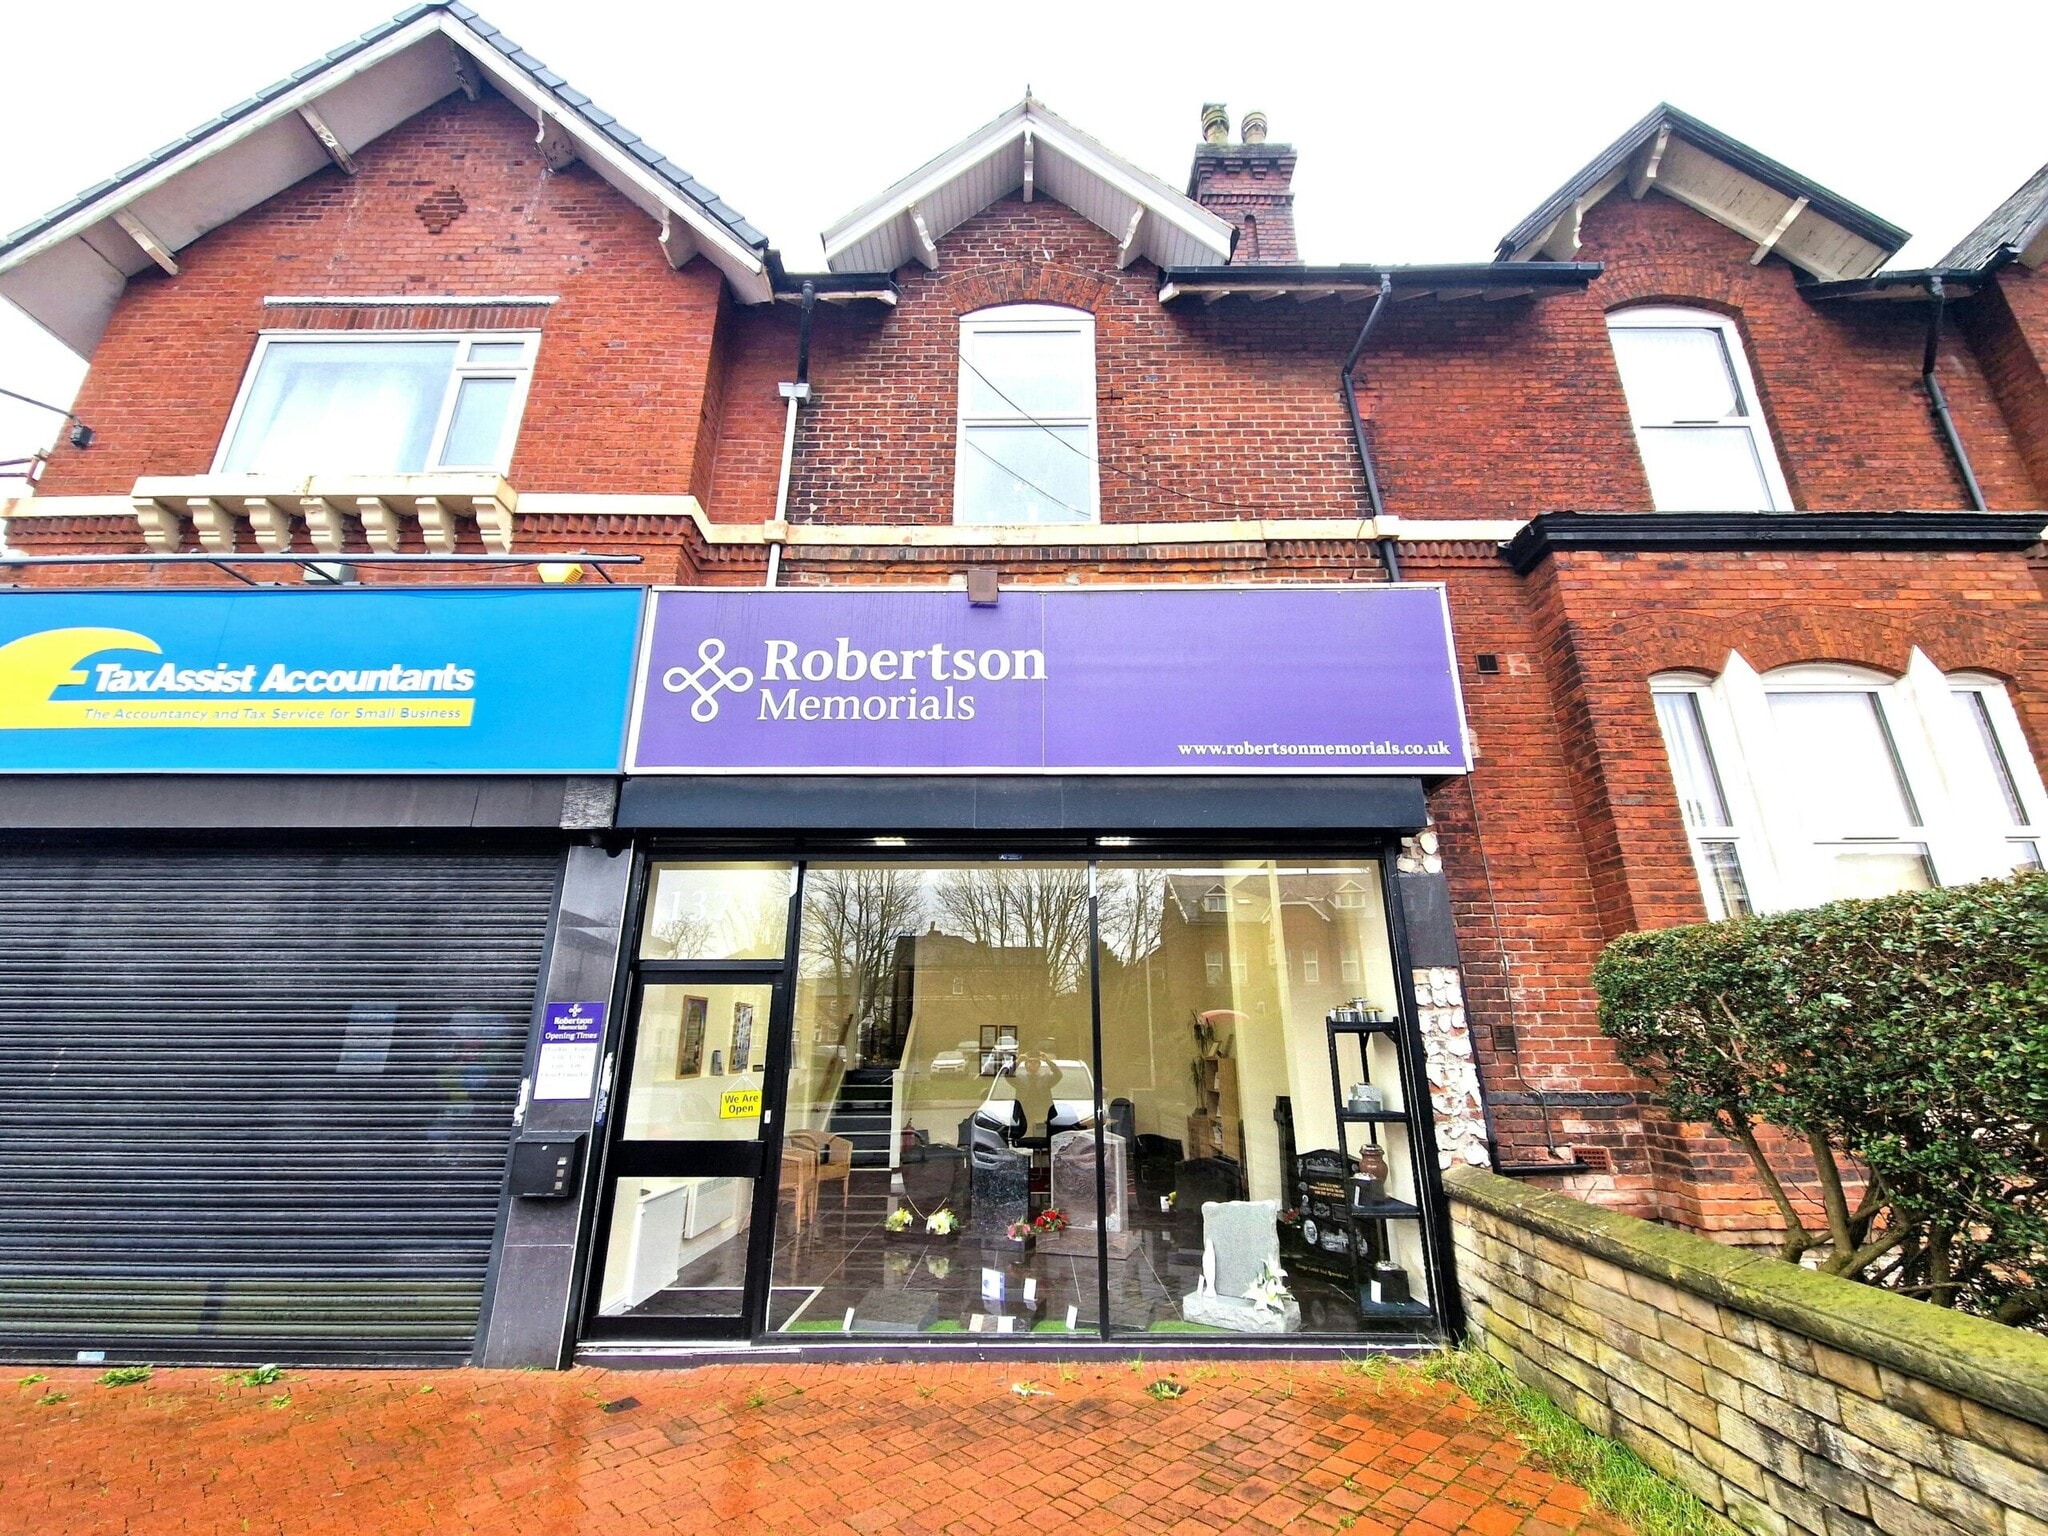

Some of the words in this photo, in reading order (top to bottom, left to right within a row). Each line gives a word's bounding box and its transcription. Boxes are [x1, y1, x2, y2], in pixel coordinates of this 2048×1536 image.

[760, 637, 1048, 682] Robertson
[95, 662, 257, 693] TaxAssist
[258, 663, 475, 693] Accountants
[756, 686, 976, 721] Memorials
[85, 708, 110, 720] The
[113, 708, 208, 721] Accountancy
[214, 708, 239, 720] and
[243, 708, 265, 720] Tax
[271, 708, 325, 720] Service
[329, 707, 350, 719] for
[355, 707, 395, 719] Small
[400, 707, 461, 719] Business
[1177, 740, 1451, 756] www.robertsonmemorials.co.uk
[553, 1016, 593, 1025] Robertson
[545, 1031, 575, 1041] Opening
[576, 1031, 598, 1039] Times
[725, 1095, 739, 1104] We
[742, 1094, 759, 1103] Are
[728, 1104, 754, 1115] Open
